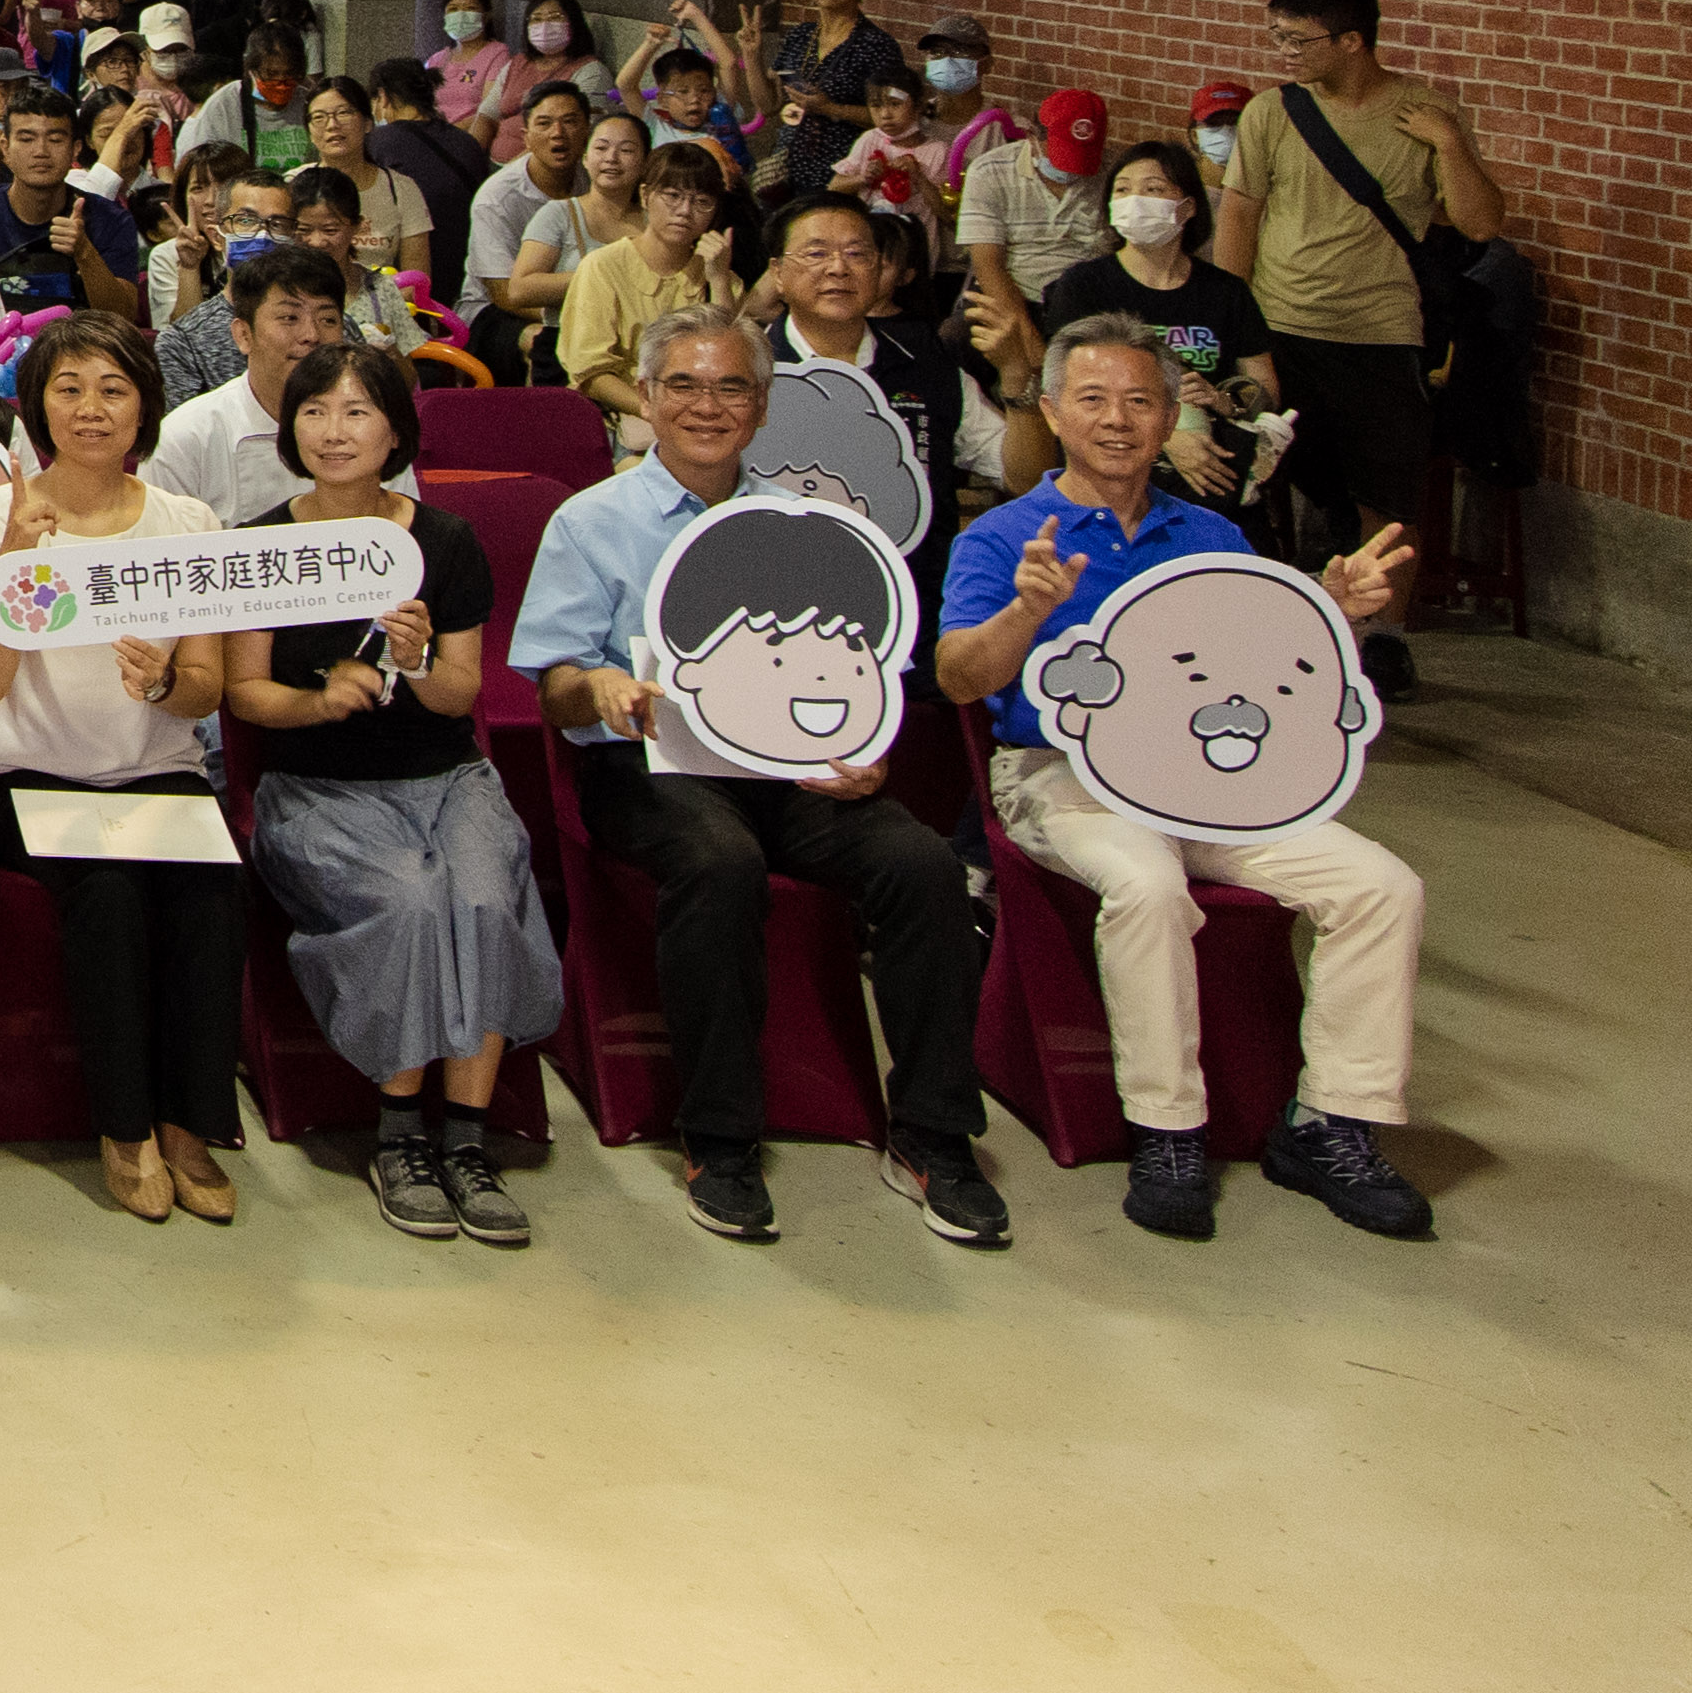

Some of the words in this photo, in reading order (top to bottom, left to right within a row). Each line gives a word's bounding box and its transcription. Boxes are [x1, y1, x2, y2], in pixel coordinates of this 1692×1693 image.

[351, 234, 395, 249] overy
[85, 540, 395, 606] 臺中市家庭教育中心
[93, 609, 169, 627] Taichung
[178, 602, 234, 619] Family
[243, 594, 327, 613] Education
[336, 588, 392, 605] Center
